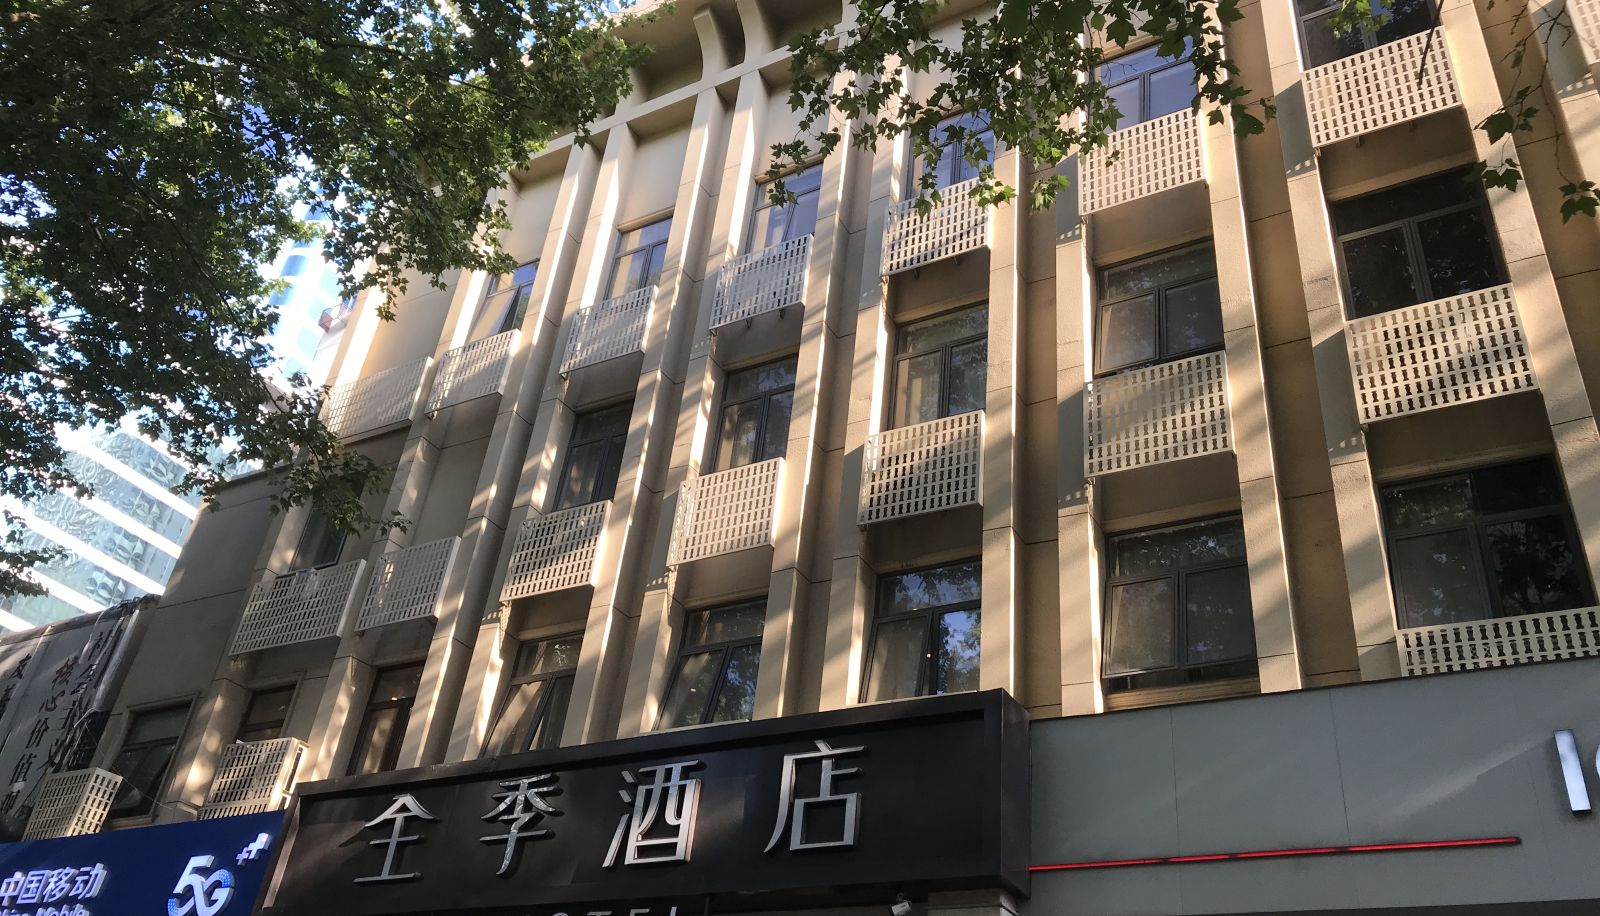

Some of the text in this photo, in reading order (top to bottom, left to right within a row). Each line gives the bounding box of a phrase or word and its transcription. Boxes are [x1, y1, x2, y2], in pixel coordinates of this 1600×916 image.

[353, 739, 867, 884] 全季酒店
[0, 862, 107, 906] 中国移动
